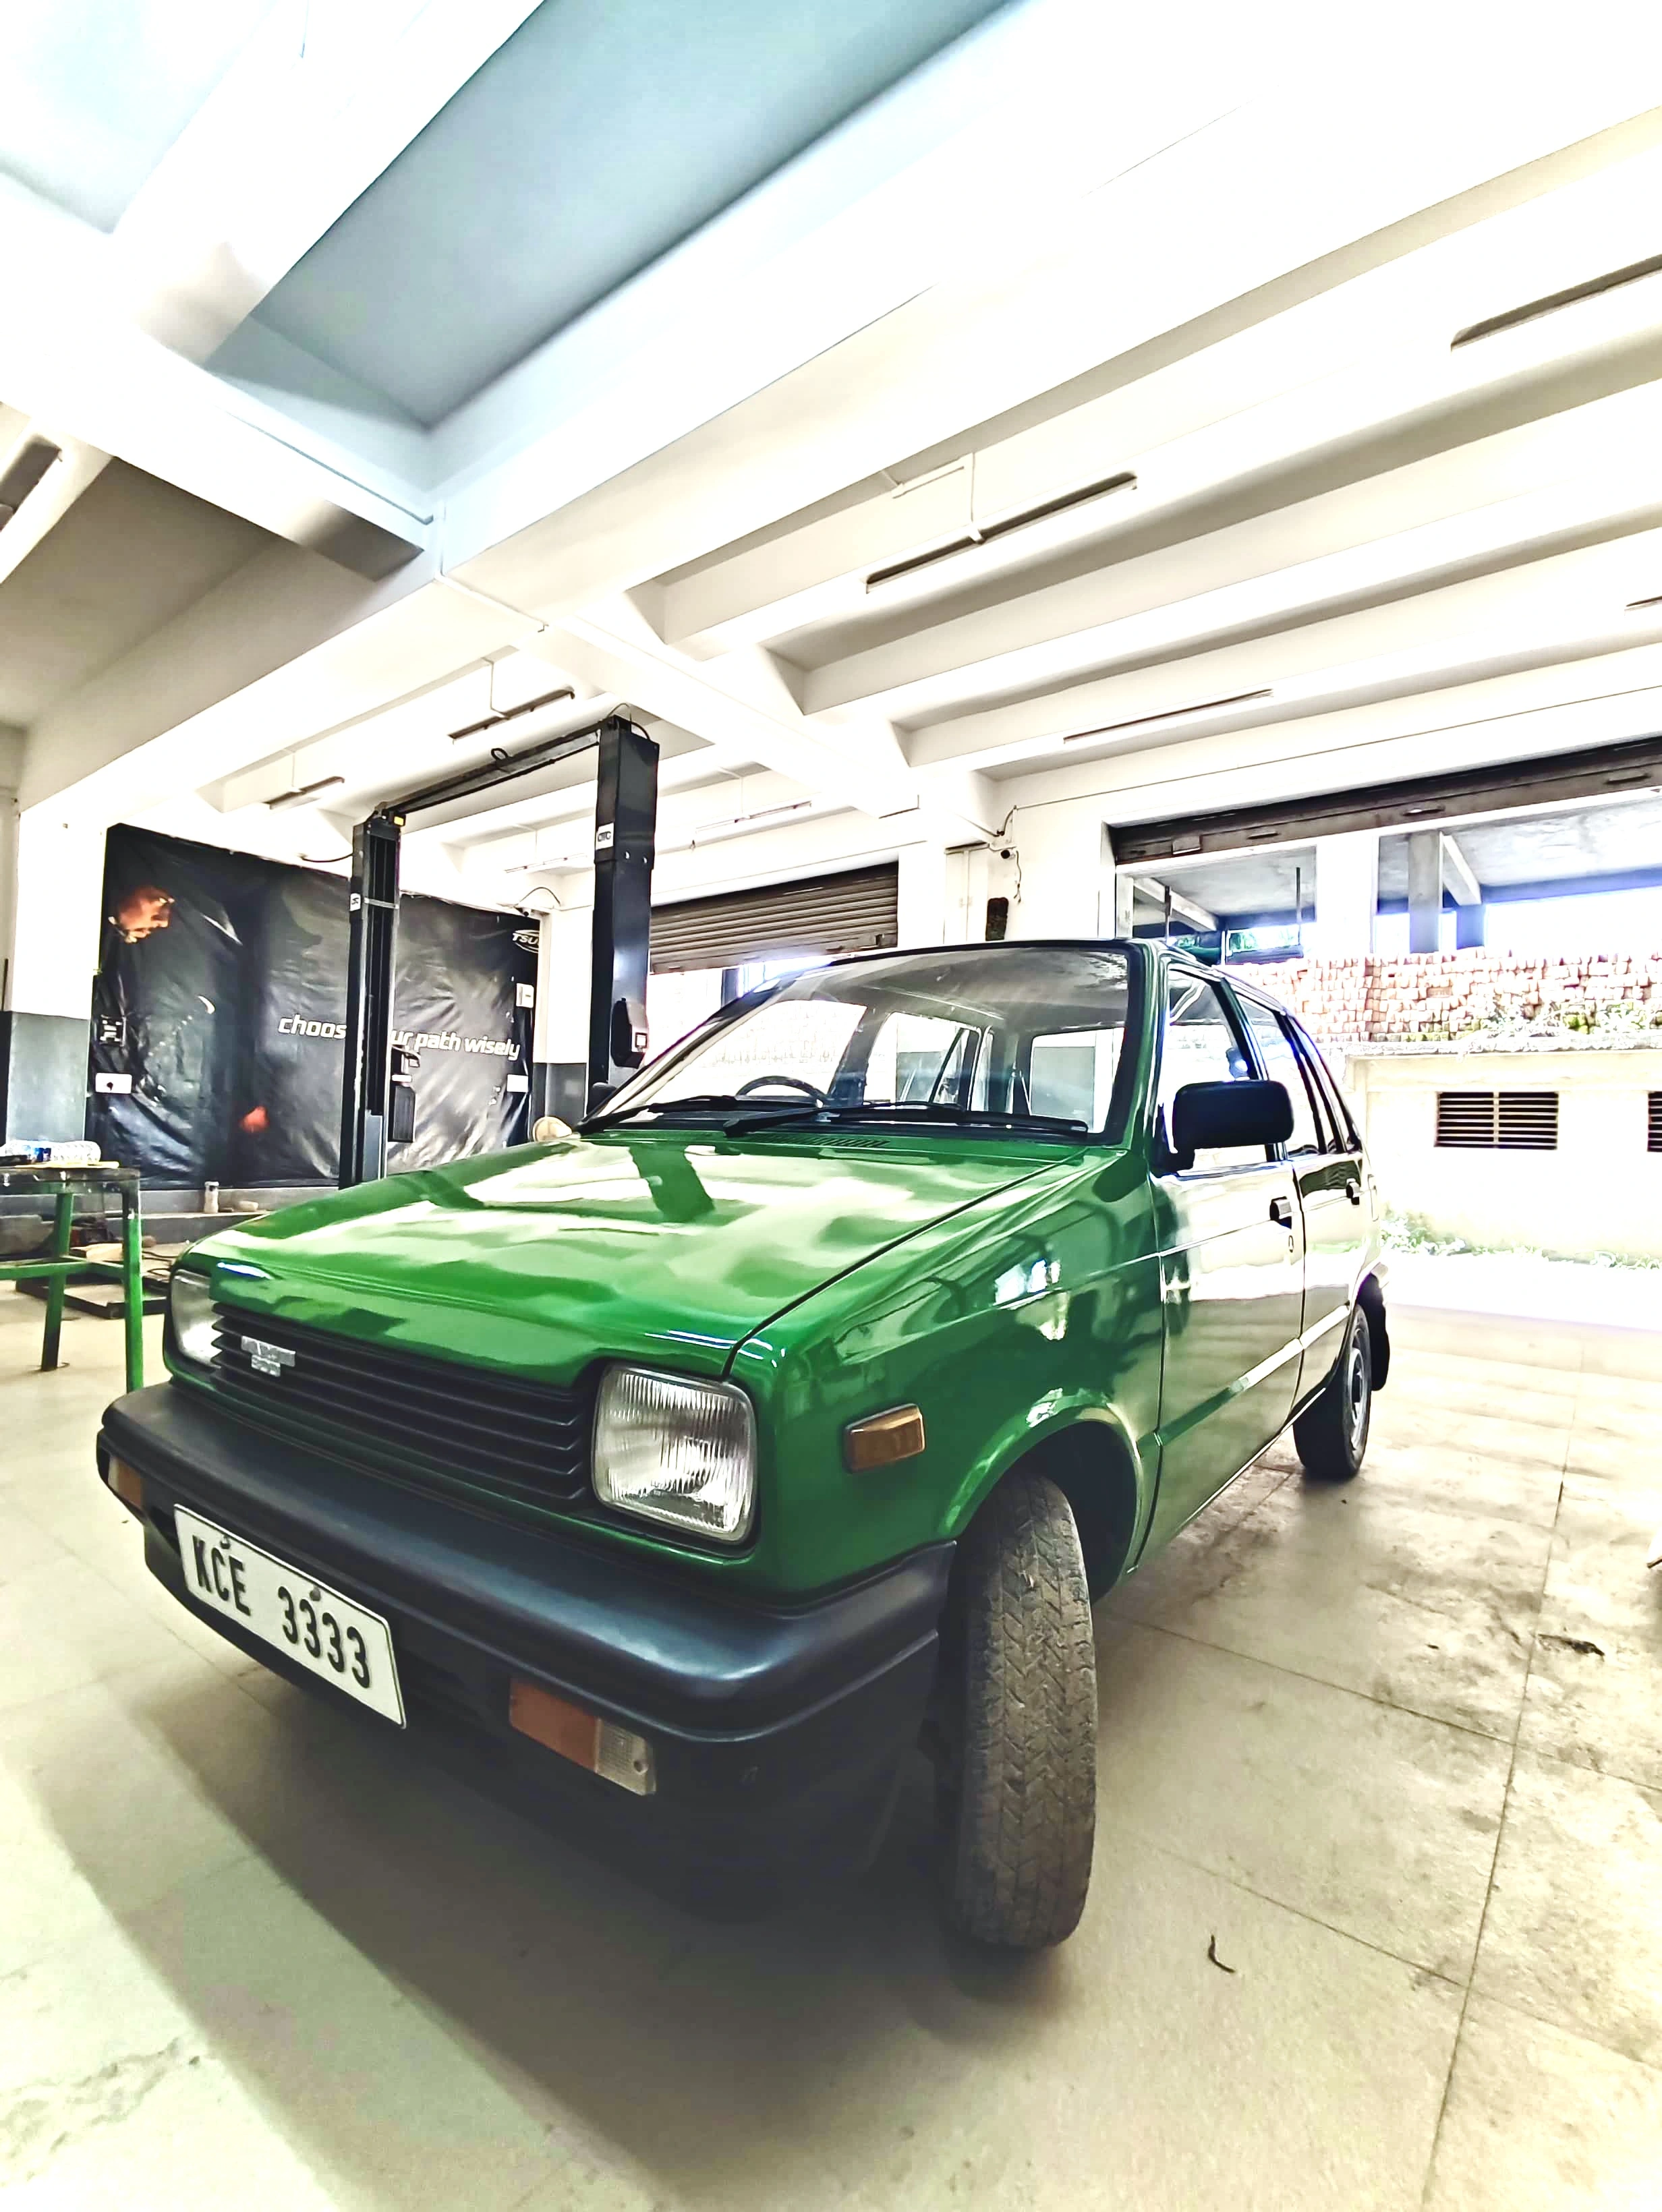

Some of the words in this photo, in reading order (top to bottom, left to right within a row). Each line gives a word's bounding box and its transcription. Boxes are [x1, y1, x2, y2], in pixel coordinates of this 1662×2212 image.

[513, 933, 539, 945] TSU
[278, 1014, 347, 1039] choos
[390, 1030, 413, 1049] ur
[415, 1031, 461, 1052] path
[464, 1035, 521, 1061] wisely
[192, 1534, 252, 1617] KCE
[277, 1585, 372, 1689] 3333
